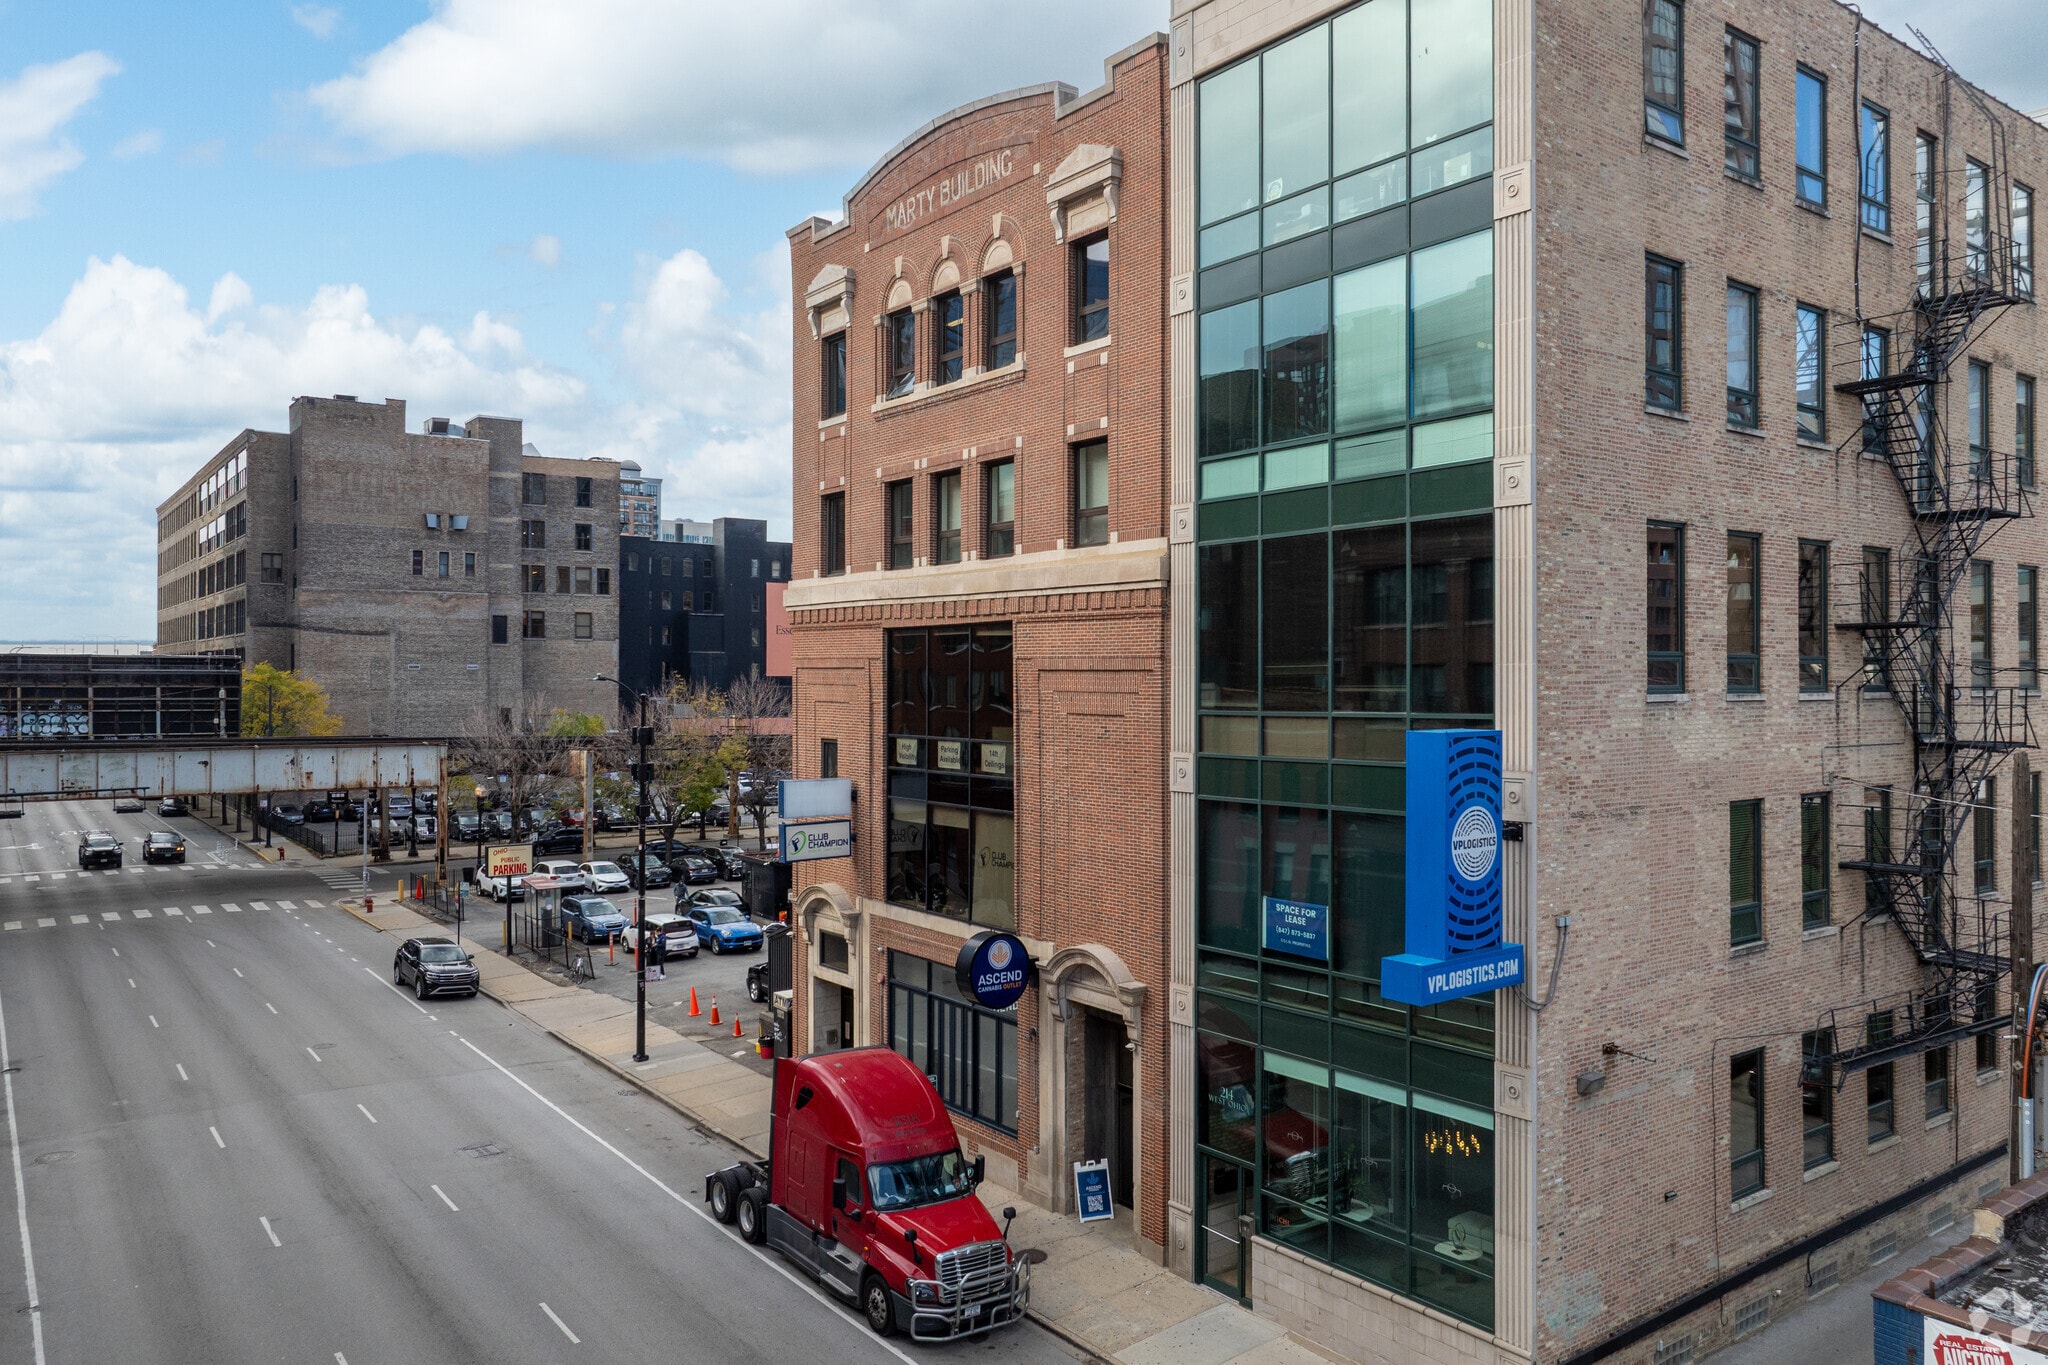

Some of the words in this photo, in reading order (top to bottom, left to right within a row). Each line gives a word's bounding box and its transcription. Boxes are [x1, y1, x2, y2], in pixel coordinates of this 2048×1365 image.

[886, 186, 935, 232] MARTY
[940, 150, 1013, 206] BUILDING
[902, 743, 912, 752] High
[941, 745, 958, 755] Parking
[985, 760, 1005, 771] Ceilings
[808, 832, 829, 841] CLUB
[1453, 836, 1496, 850] VPLOGISTICS
[808, 838, 849, 849] CHAMPION
[493, 848, 508, 856] OHIO
[493, 862, 527, 875] PARKING
[1275, 904, 1299, 915] SPACE
[1301, 908, 1316, 918] FOR
[1285, 914, 1307, 926] LEASE
[978, 969, 1022, 986] ASCEND
[1427, 958, 1519, 994] VPLOGISTICS.COM
[978, 985, 1002, 993] CANNABIS
[1220, 1086, 1233, 1100] 214
[1208, 1093, 1225, 1105] WEST
[1227, 1100, 1246, 1112] OHIO
[1939, 1339, 1963, 1349] REAL
[1966, 1343, 2000, 1354] ESTATE
[1943, 1346, 2005, 1365] AUCTION
